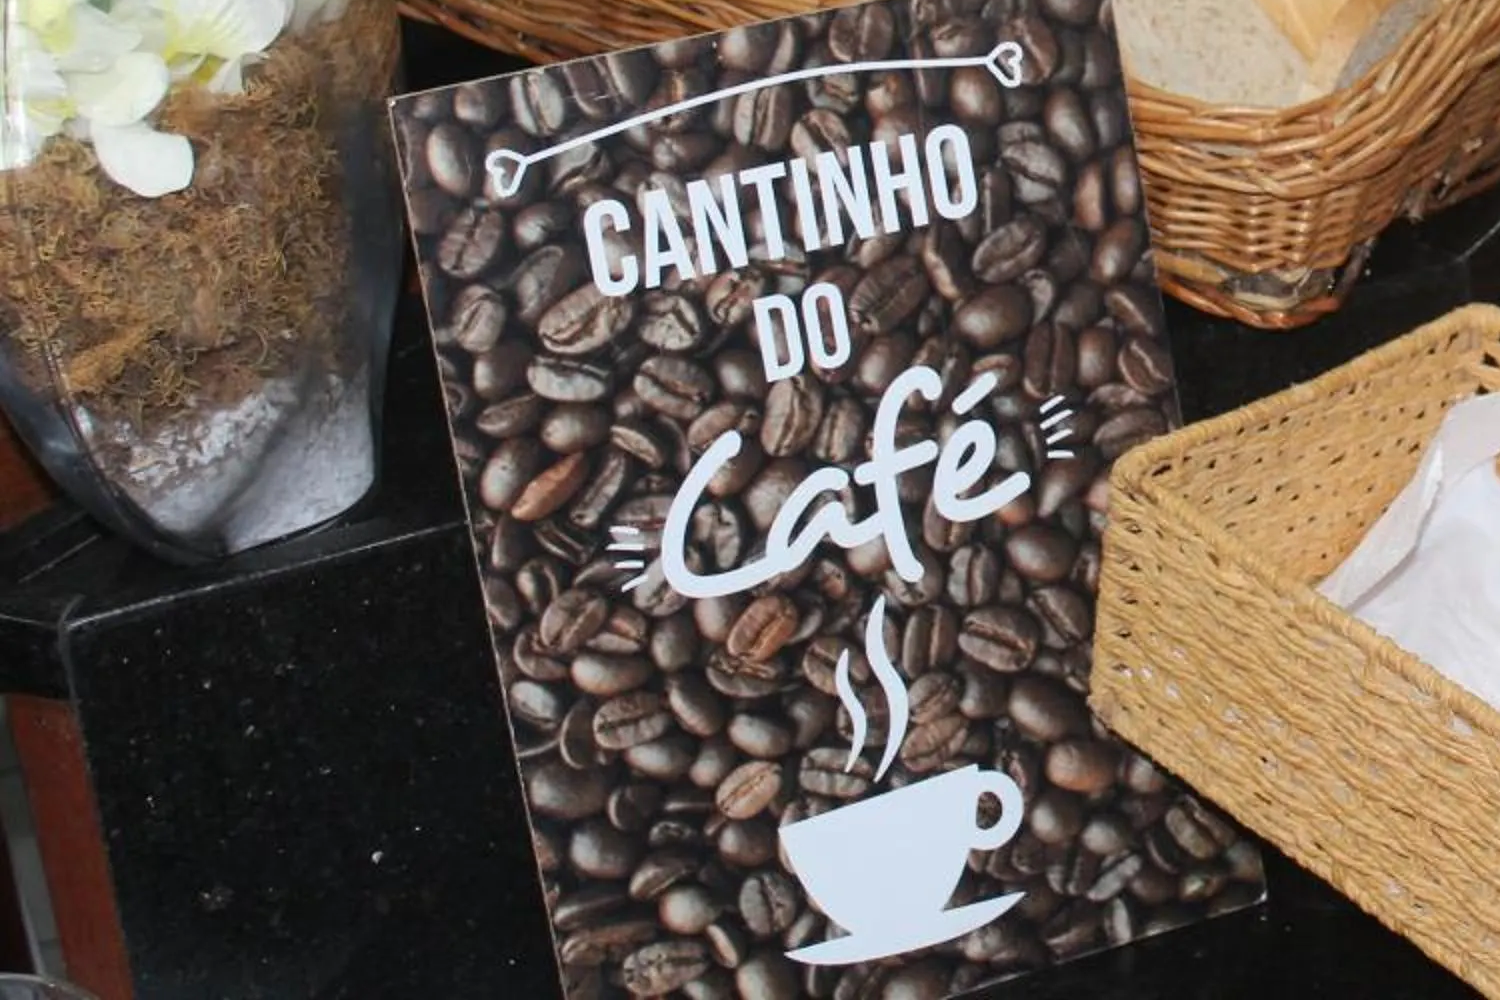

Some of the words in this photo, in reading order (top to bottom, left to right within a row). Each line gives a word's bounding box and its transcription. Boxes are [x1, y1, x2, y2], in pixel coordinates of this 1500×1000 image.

[583, 124, 977, 297] CANTINHO
[753, 282, 851, 383] DO
[661, 365, 1031, 599] Café
